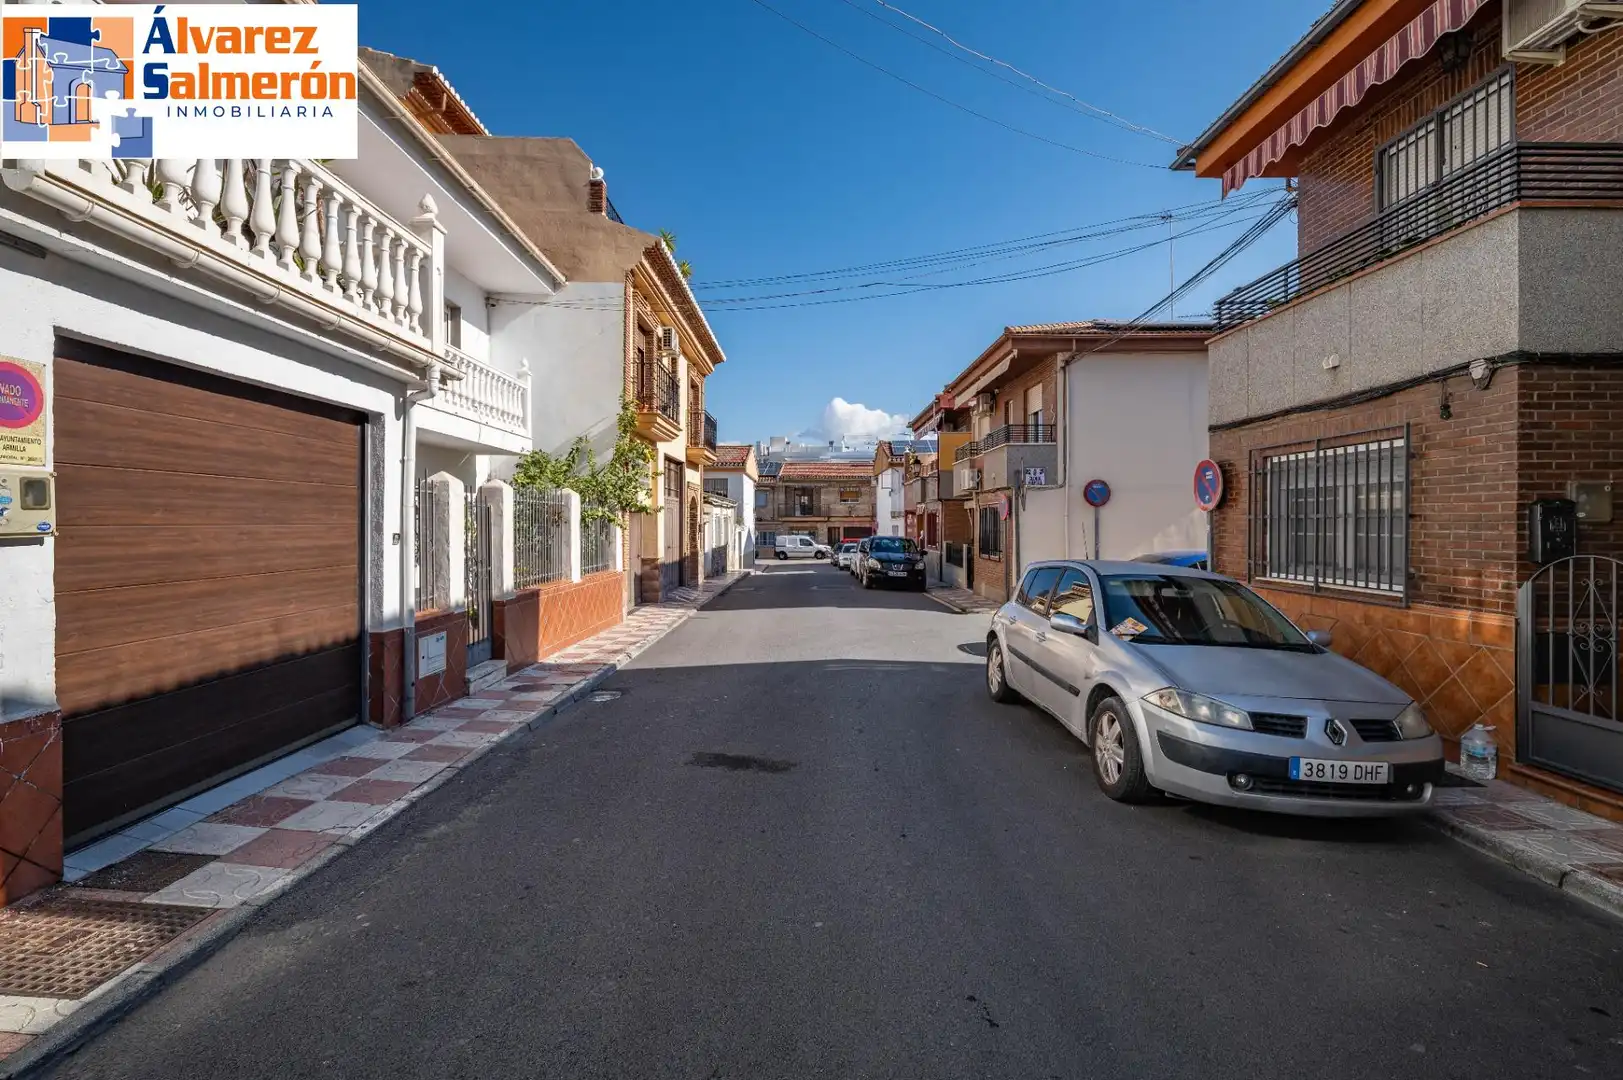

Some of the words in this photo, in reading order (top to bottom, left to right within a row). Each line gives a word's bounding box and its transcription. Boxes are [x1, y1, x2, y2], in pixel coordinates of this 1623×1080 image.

[2, 444, 27, 452] ARMILLA
[1304, 762, 1348, 780] 3819
[1354, 765, 1384, 781] DHF
